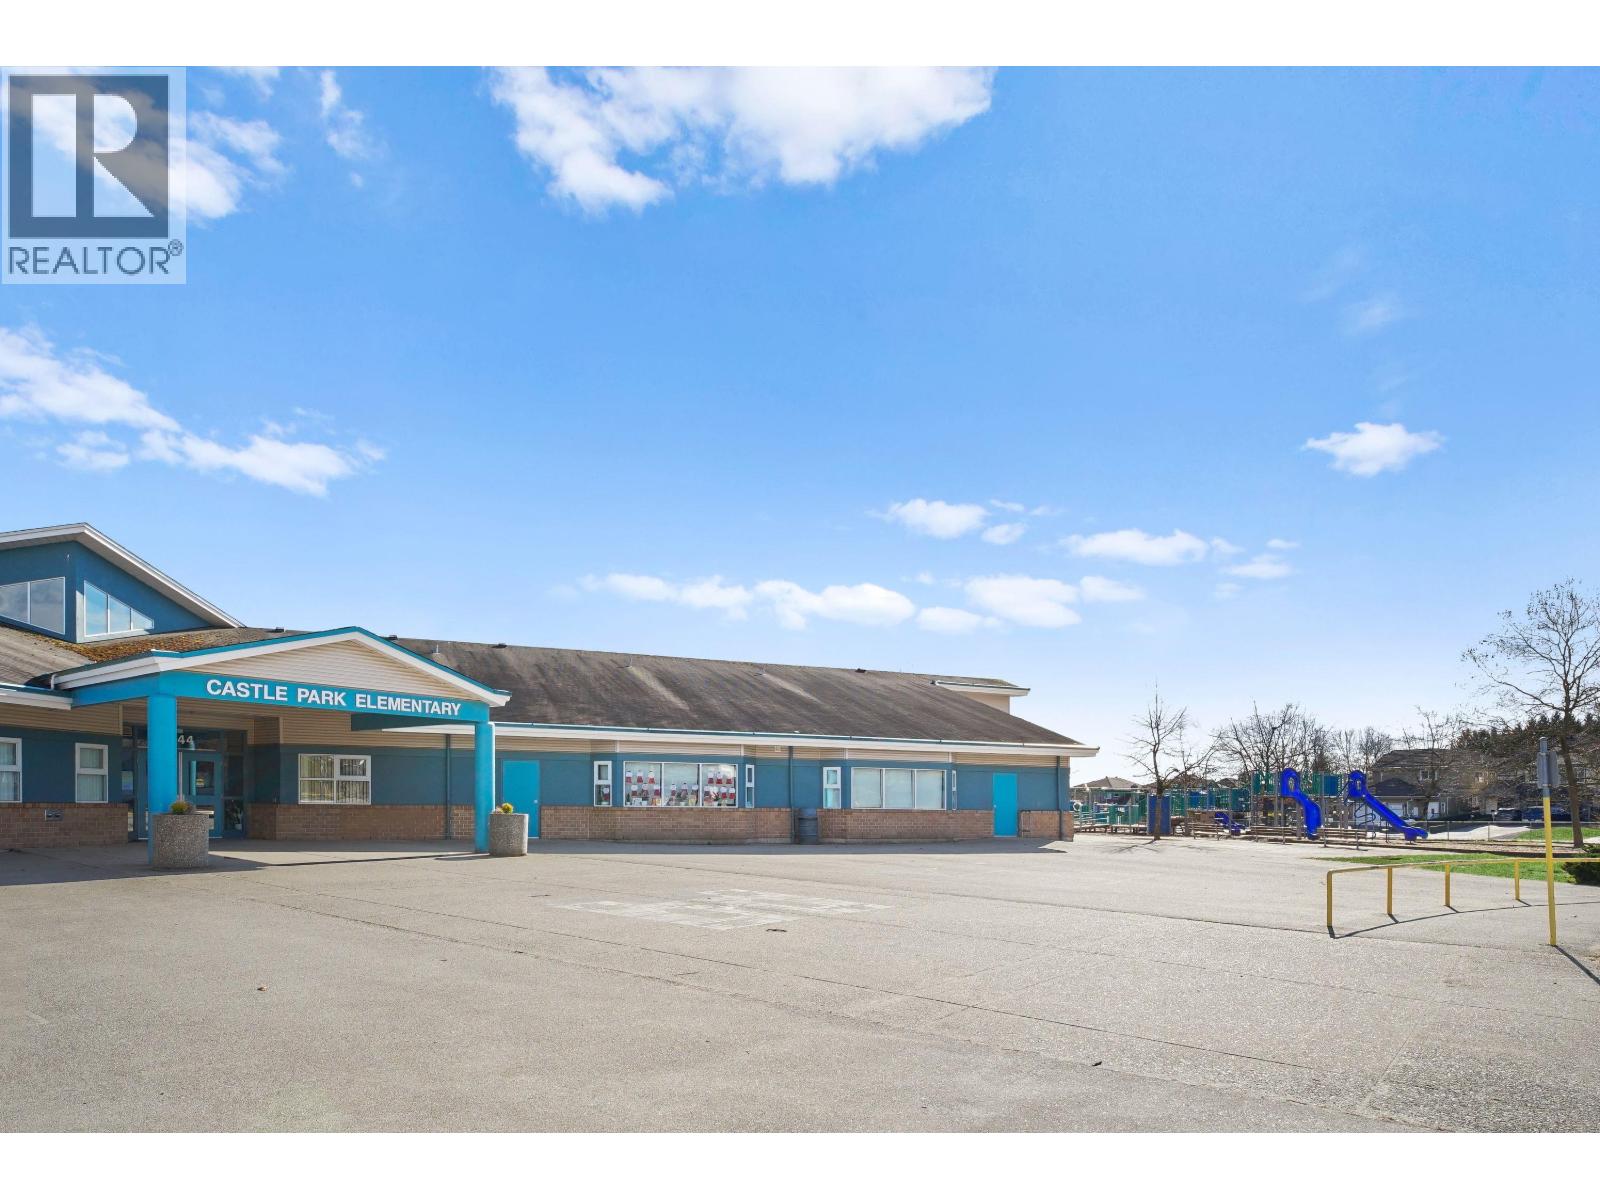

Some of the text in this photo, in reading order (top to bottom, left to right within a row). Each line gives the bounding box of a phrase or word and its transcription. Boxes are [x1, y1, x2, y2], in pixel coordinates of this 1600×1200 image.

[206, 679, 462, 716] CASTLE PARK ELEMENTARY
